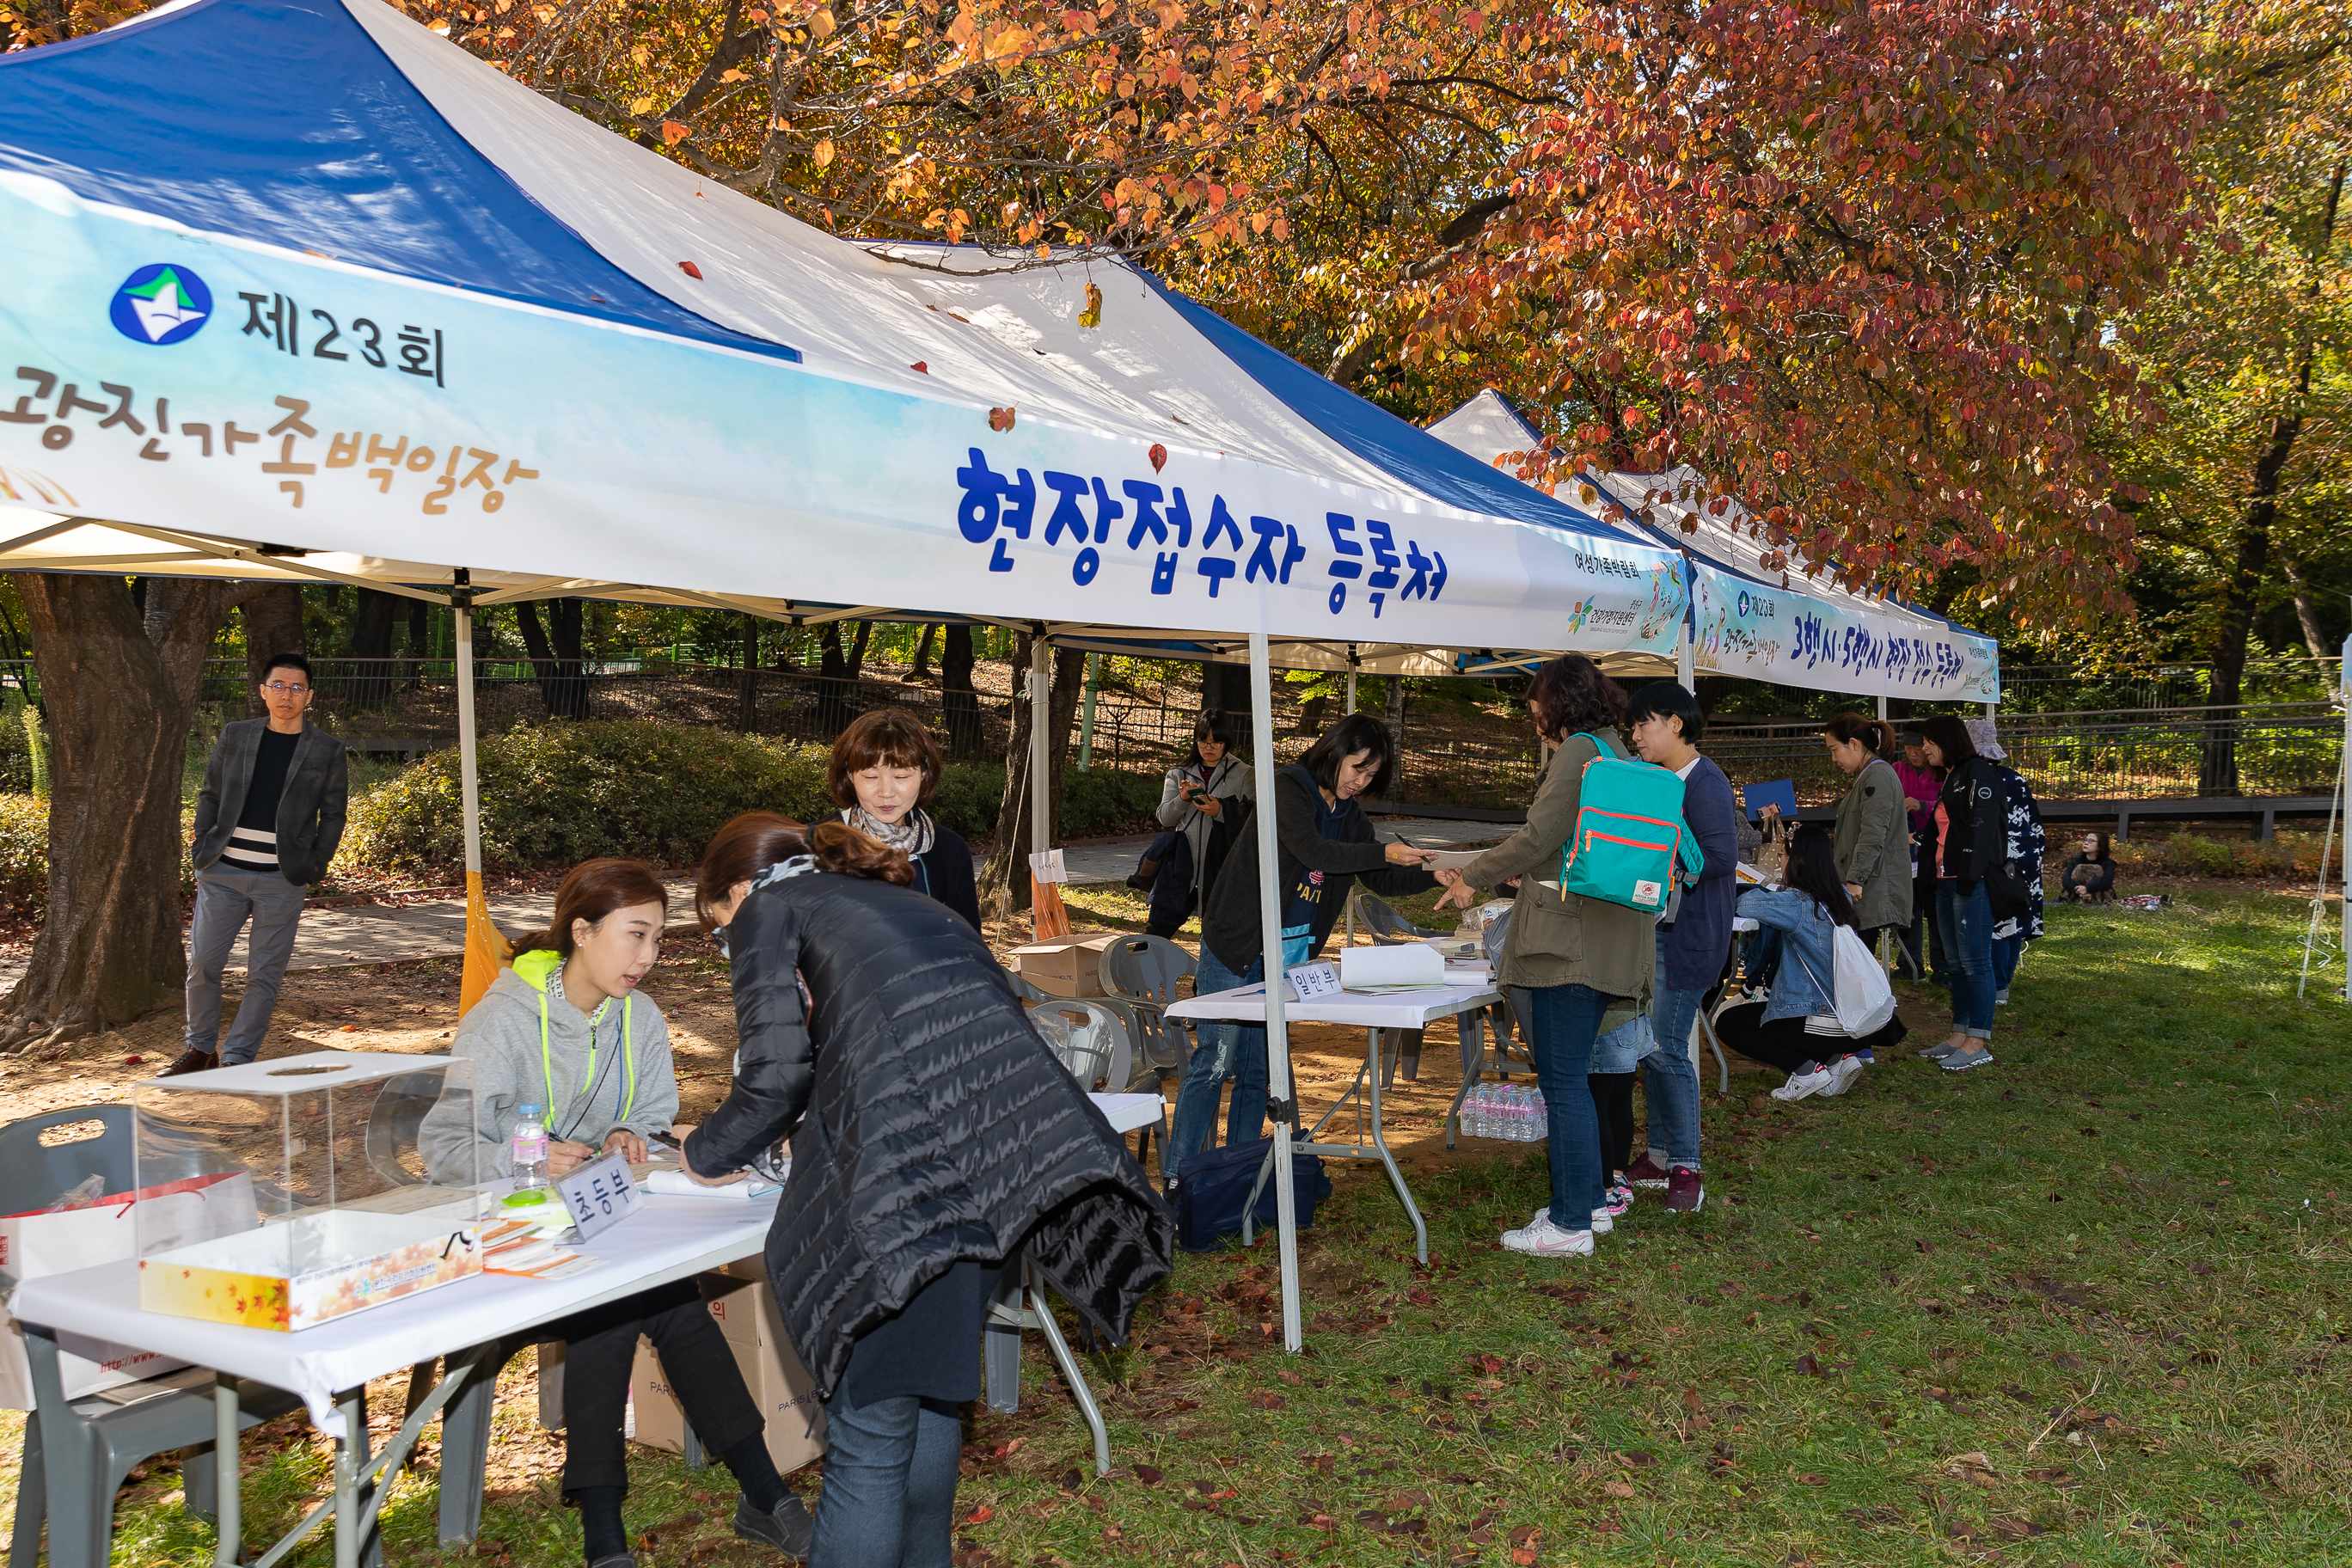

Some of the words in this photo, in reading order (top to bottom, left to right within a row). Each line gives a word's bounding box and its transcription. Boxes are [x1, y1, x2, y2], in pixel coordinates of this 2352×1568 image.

[238, 291, 445, 388] 제23회
[0, 366, 539, 515] 광진가족백일장
[956, 446, 1307, 599] 현장접수자
[1326, 511, 1449, 619] 등록처
[1574, 552, 1641, 580] 여성가족박람회
[1589, 609, 1637, 627] 건강가정지원센터
[1751, 595, 1774, 620] 제23회
[1724, 628, 1780, 666] 광진가족백일장
[1931, 642, 1964, 689] 등록처
[1295, 969, 1337, 996] 일반부
[574, 1168, 630, 1224] 초등부
[713, 1301, 726, 1320] 의
[778, 1394, 806, 1412] PARIS
